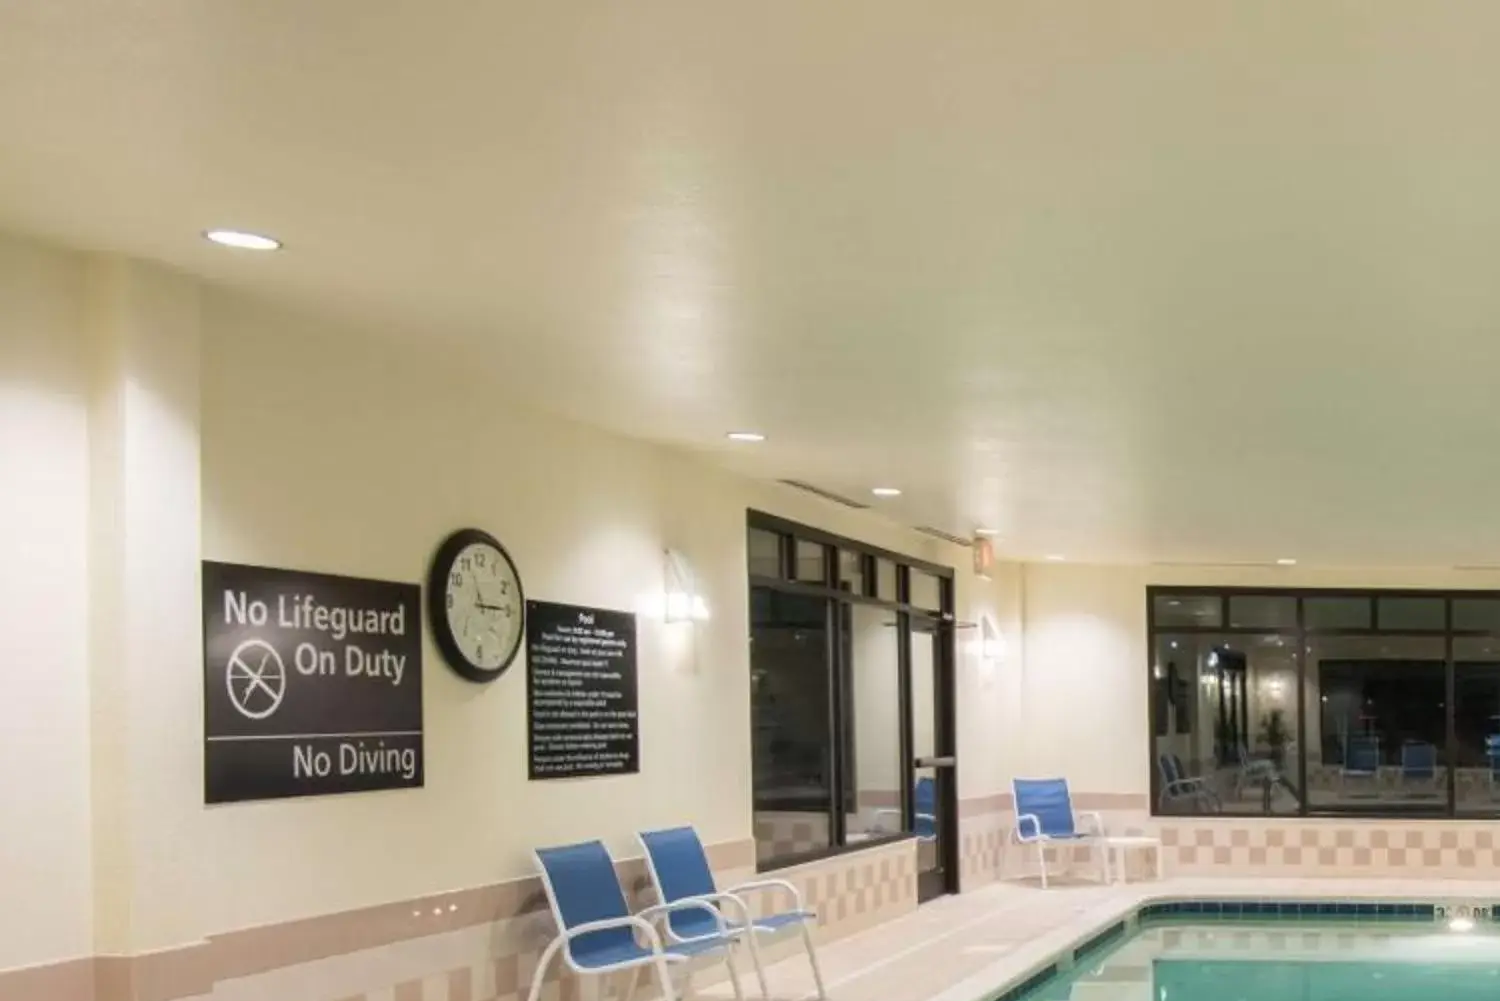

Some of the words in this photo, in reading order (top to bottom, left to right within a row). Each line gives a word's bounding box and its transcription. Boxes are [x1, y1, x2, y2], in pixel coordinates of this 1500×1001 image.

[461, 558, 471, 572] 11
[474, 553, 486, 568] 12
[452, 572, 463, 588] 10
[500, 580, 510, 595] 2
[224, 590, 268, 626] No
[278, 595, 405, 640] Lifeguard
[295, 643, 335, 675] On
[345, 645, 406, 686] Duty
[293, 745, 331, 778] No
[340, 742, 415, 779] Diving
